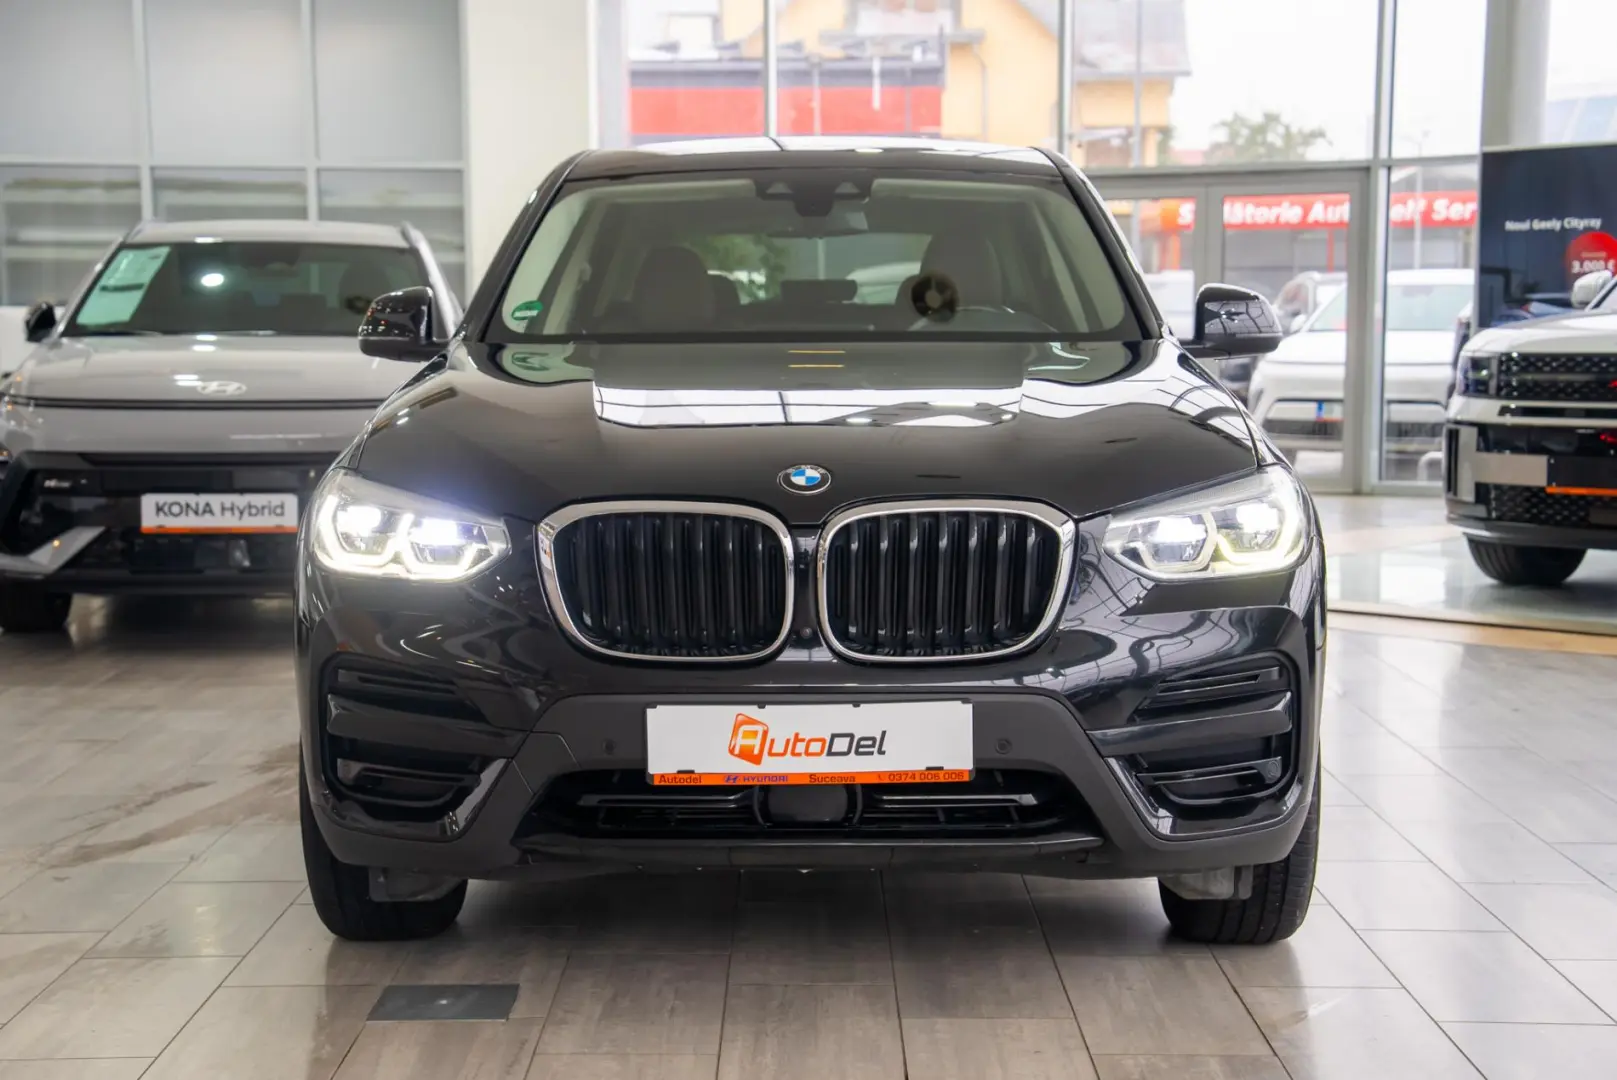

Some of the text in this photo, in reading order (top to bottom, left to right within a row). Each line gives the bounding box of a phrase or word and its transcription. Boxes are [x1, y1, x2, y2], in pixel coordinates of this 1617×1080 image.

[1307, 200, 1350, 223] Aut
[1390, 198, 1427, 222] elf
[1532, 218, 1562, 232] Geely
[1563, 217, 1602, 230] Cityray
[155, 501, 285, 520] KONA Hybrid
[731, 720, 886, 759] AutoDel
[658, 771, 964, 784] Autodel HYUNDAI Suceava 0374 006 006
